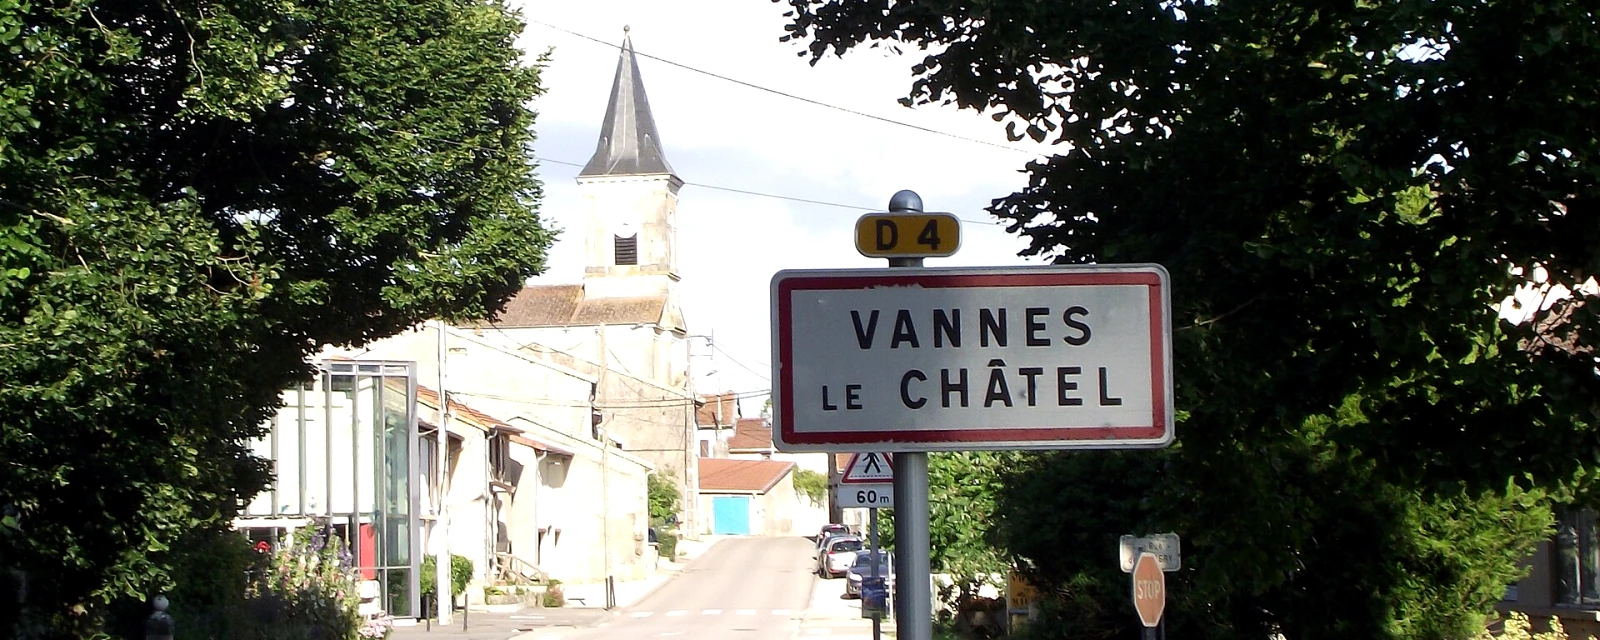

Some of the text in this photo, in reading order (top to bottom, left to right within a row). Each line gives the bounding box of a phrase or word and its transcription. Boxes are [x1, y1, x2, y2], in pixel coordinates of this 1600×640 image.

[875, 219, 941, 251] D 4
[850, 306, 1093, 350] VANNES
[822, 358, 1123, 411] LE CHÂTEL
[856, 490, 890, 504] 60 m
[1137, 580, 1161, 600] STOP
